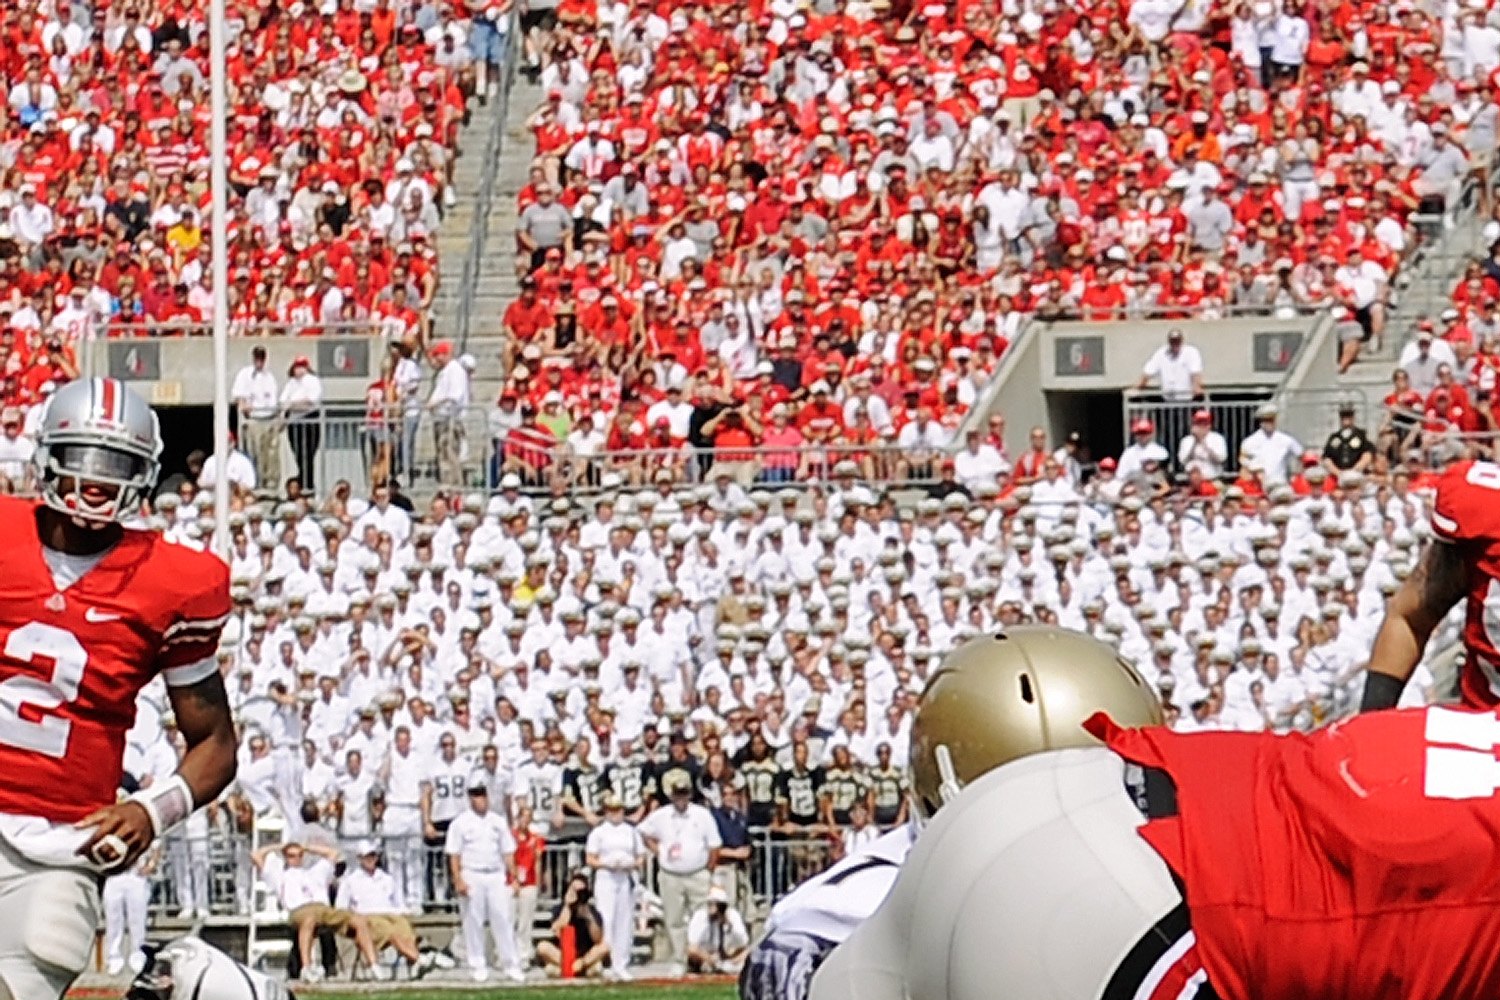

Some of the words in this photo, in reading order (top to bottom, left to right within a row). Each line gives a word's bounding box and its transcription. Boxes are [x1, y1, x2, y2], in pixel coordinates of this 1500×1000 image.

[0, 620, 89, 759] 2
[435, 774, 466, 800] 58
[528, 784, 553, 811] 12
